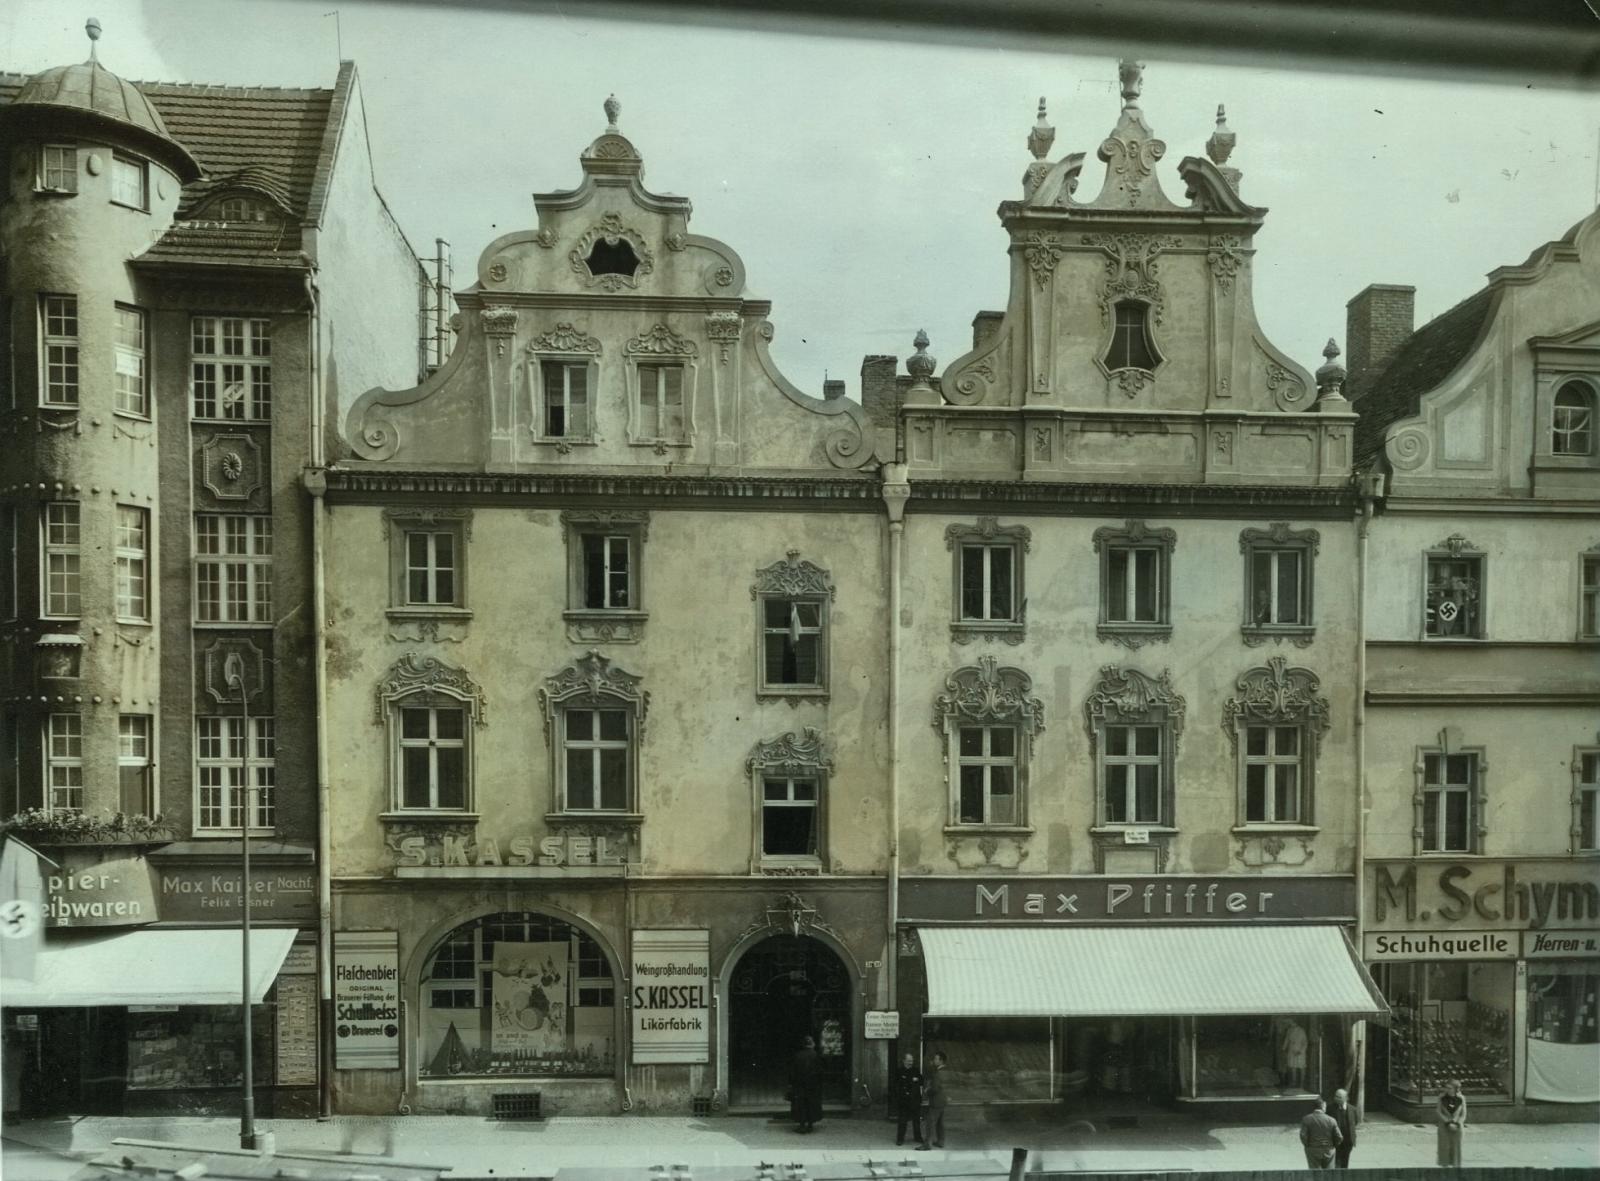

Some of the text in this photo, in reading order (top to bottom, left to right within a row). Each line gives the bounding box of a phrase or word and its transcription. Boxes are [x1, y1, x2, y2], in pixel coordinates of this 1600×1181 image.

[163, 876, 203, 894] Max
[277, 876, 314, 889] Nachf.
[201, 896, 275, 908] Felix Esner
[976, 884, 1273, 914] Max Pfiffer
[1376, 935, 1508, 955] Schuhquelle
[635, 963, 708, 978] Weingroßhandlung
[634, 985, 709, 1009] S.KASSEL
[641, 1017, 702, 1031] Likörfabrik
